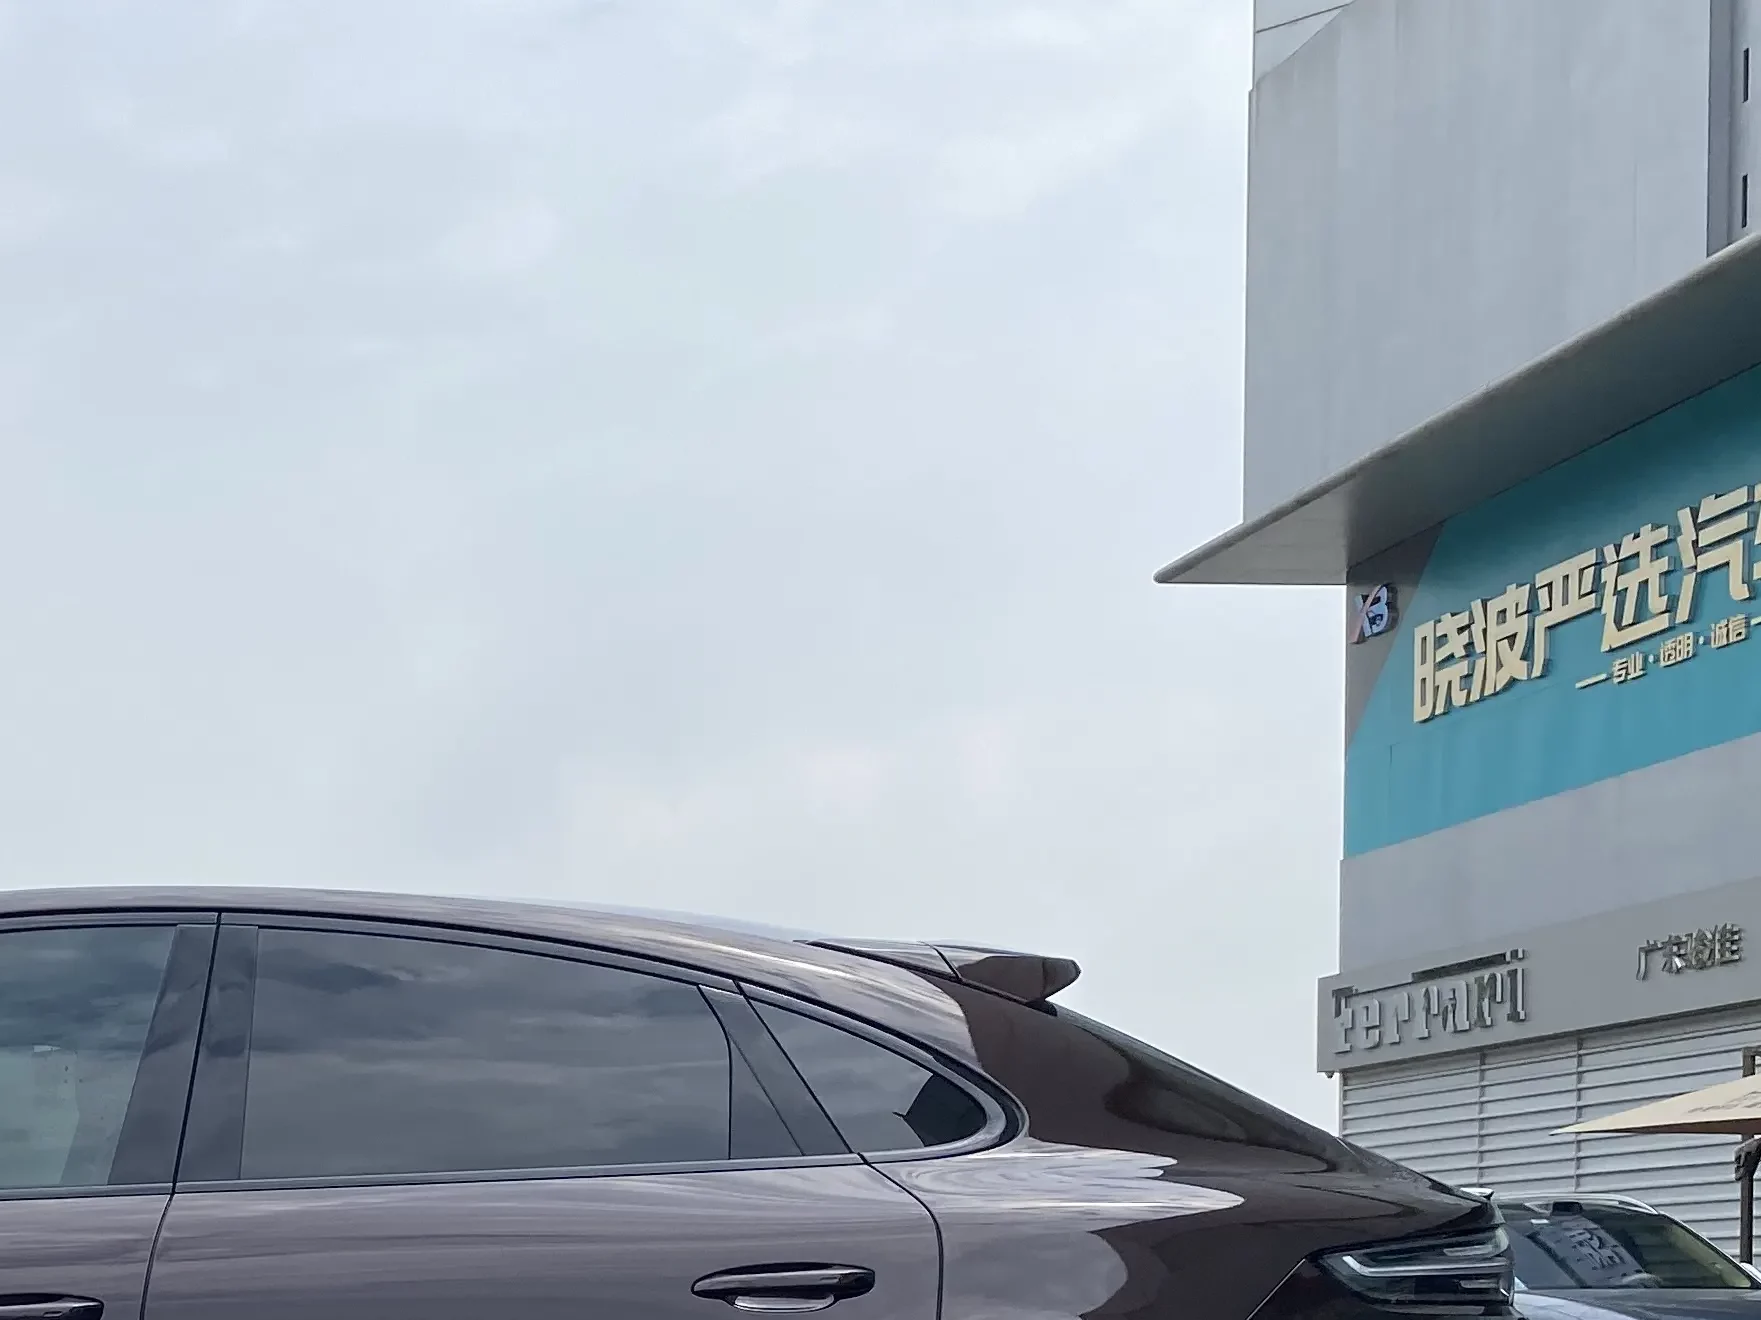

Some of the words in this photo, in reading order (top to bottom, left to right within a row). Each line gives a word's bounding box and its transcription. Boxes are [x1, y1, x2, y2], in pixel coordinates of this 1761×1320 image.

[1413, 482, 1761, 723] 晓波严选汽
[1332, 948, 1525, 1054] Ferrari
